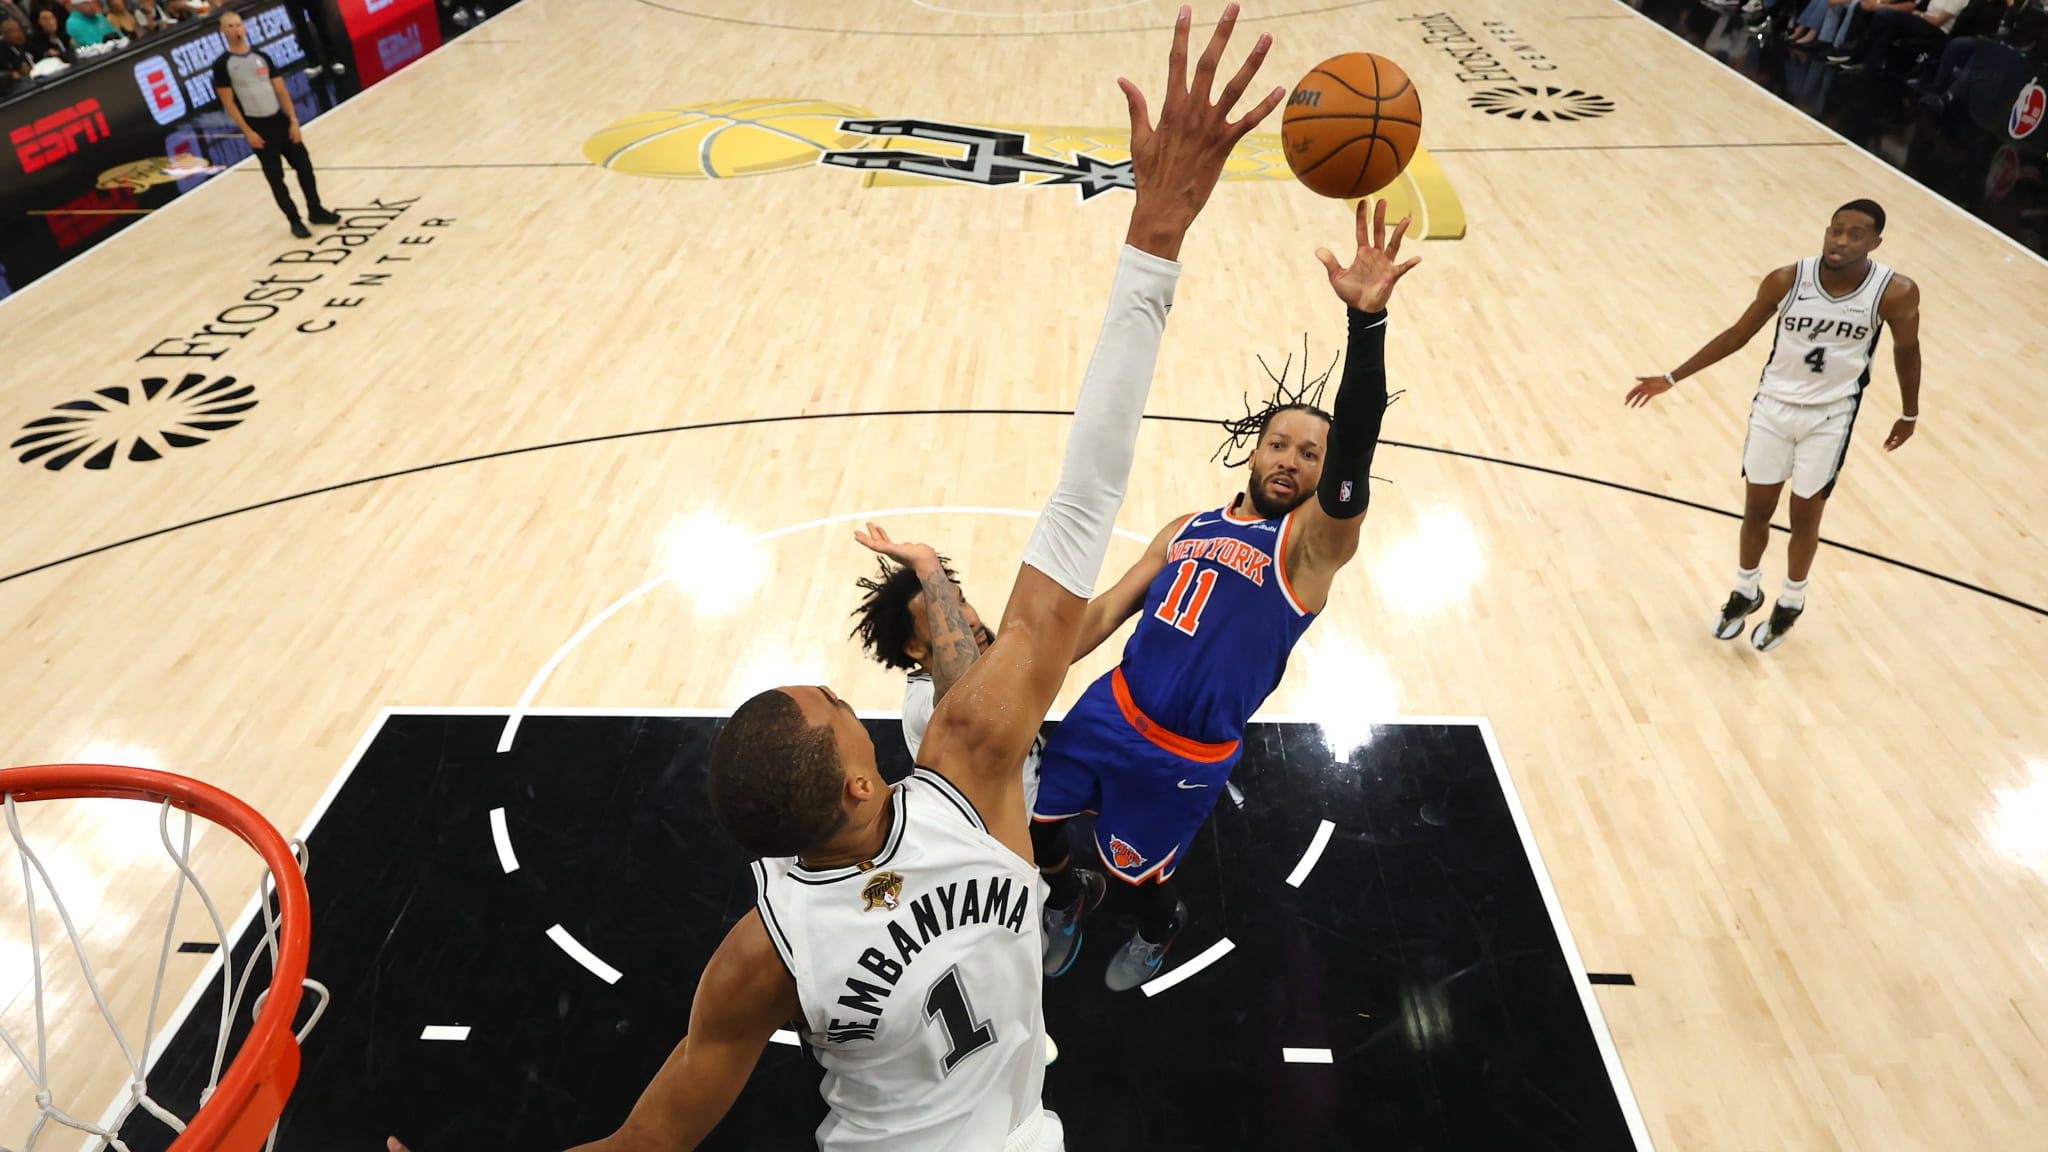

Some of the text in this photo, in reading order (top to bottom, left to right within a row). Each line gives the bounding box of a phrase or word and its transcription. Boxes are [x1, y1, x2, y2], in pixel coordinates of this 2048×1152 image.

[9, 97, 111, 174] ESPN
[135, 195, 422, 361] Frost Bank
[296, 216, 457, 334] CENTER
[1784, 316, 1869, 342] SPURS
[1804, 346, 1825, 374] 4
[1154, 558, 1219, 637] 11
[1168, 536, 1273, 588] NEW YORK
[921, 963, 998, 1079] 1
